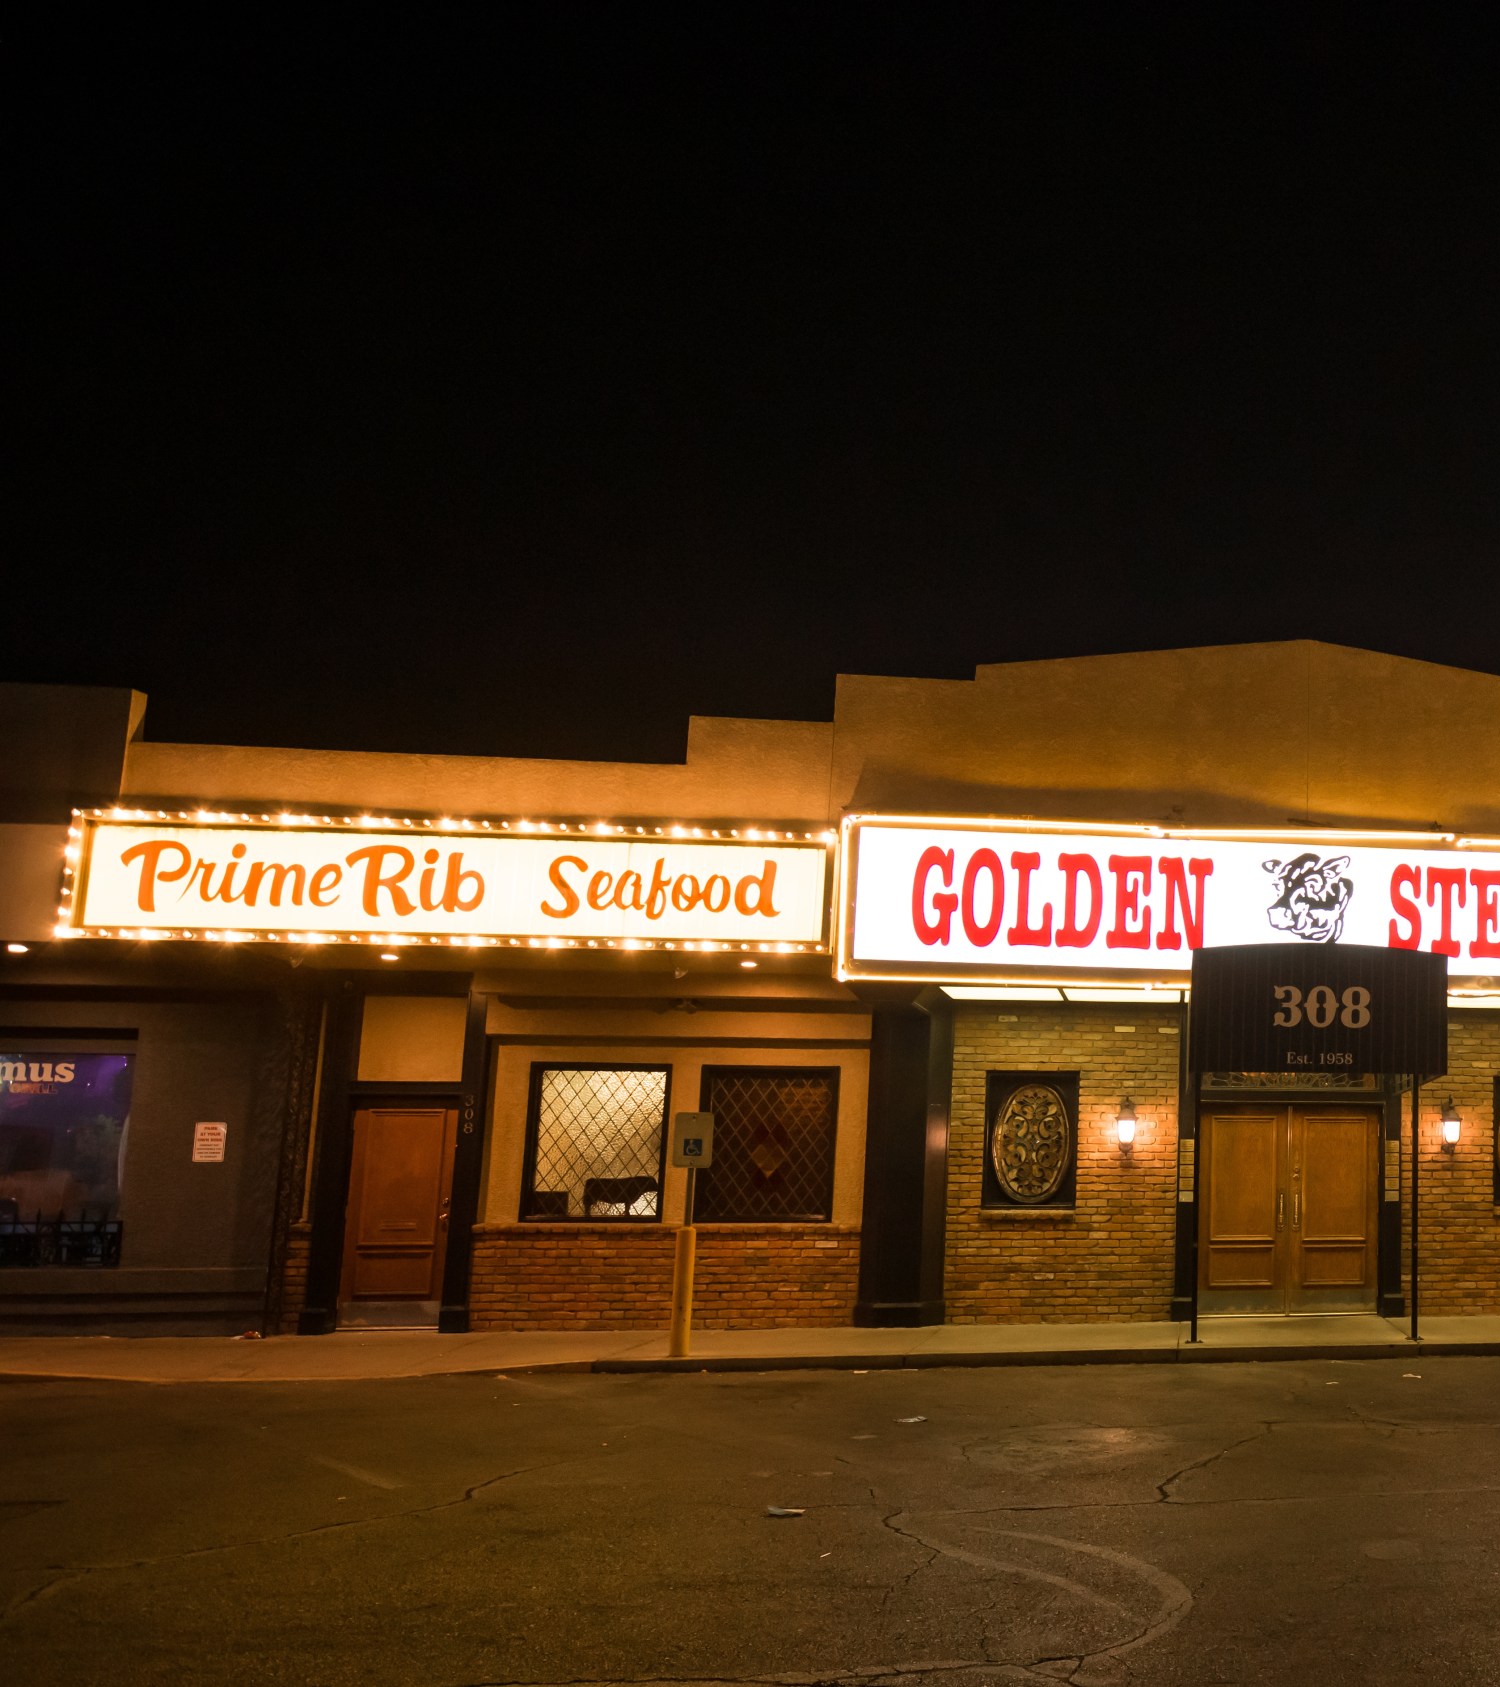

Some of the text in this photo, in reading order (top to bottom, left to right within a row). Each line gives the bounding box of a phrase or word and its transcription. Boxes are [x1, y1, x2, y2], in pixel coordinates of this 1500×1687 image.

[120, 840, 485, 917] Prime Rib
[541, 855, 781, 920] Seafood
[912, 846, 1214, 951] GOLDEN
[1273, 985, 1371, 1029] 308
[1286, 1051, 1353, 1065] Est. 1958
